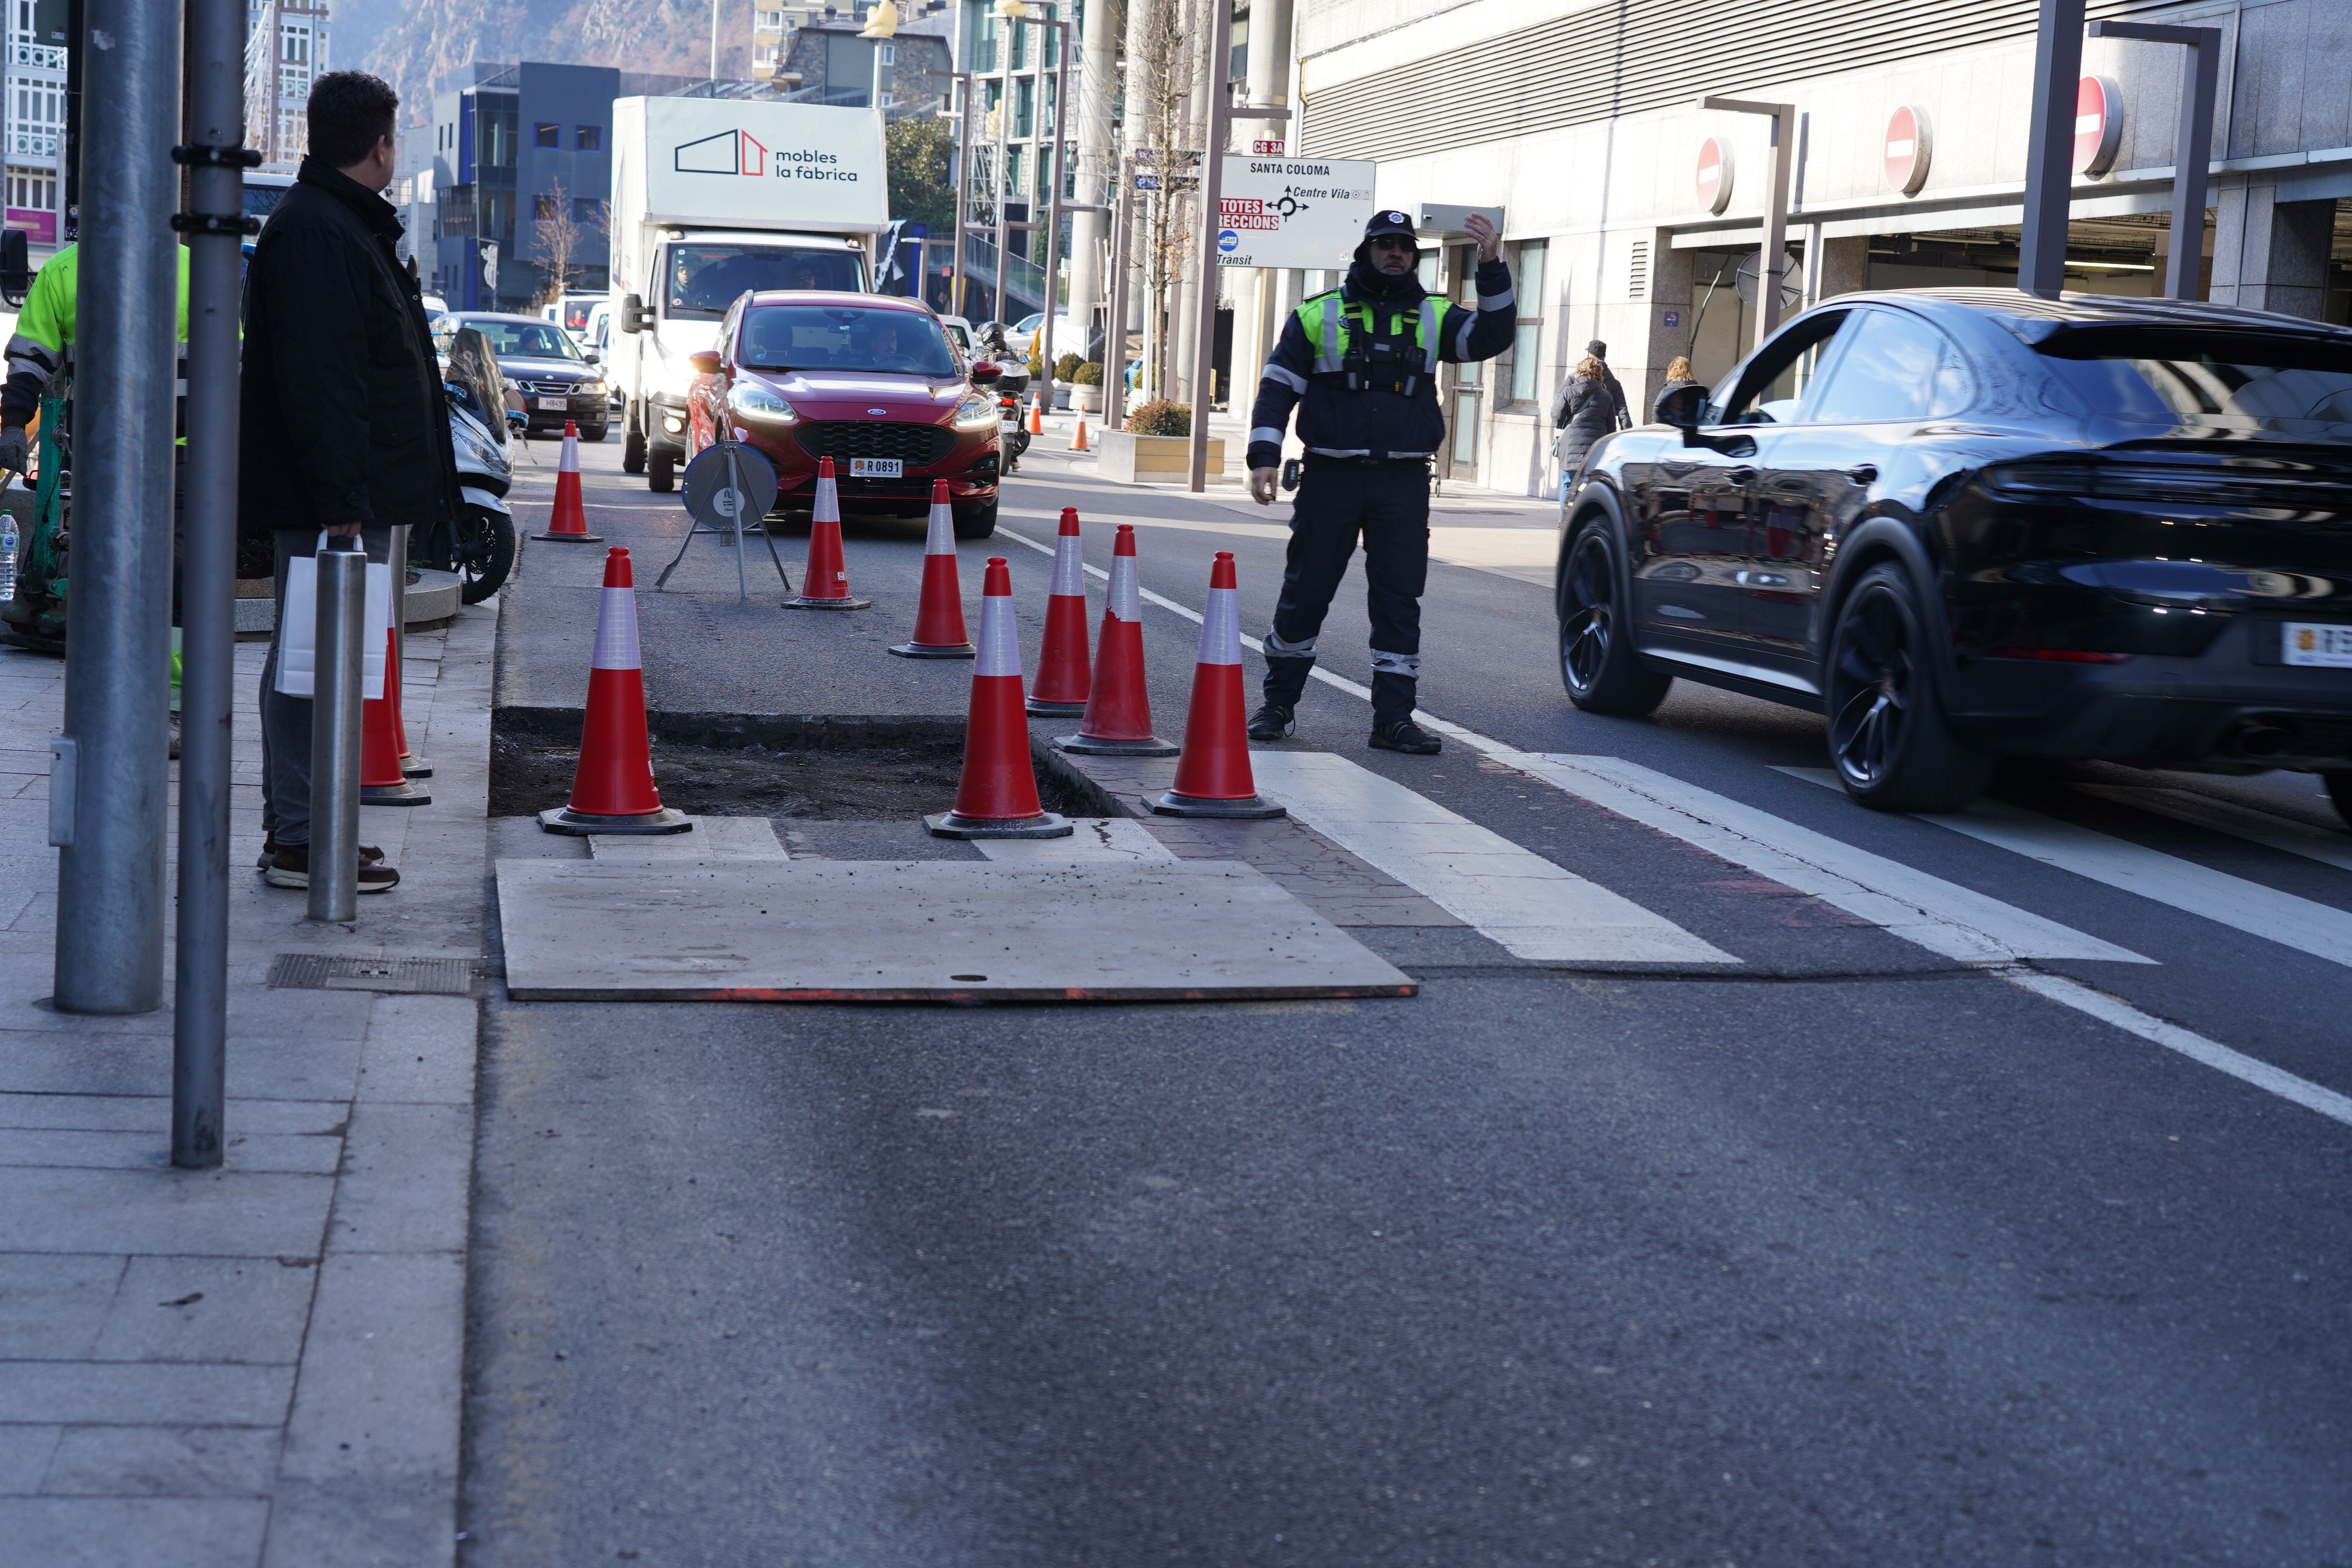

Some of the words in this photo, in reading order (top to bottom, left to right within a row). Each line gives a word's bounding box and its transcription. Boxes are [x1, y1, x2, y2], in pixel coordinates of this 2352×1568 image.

[17, 136, 56, 155] OCP
[1254, 141, 1267, 153] CG
[1270, 142, 1284, 154] 3A
[776, 149, 837, 163] mobles
[776, 165, 791, 177] la
[795, 166, 858, 181] fàbrica
[1250, 163, 1283, 174] SANTA
[1287, 164, 1330, 176] COLOMA
[1293, 186, 1327, 198] Centre
[1331, 189, 1350, 199] Vila
[1221, 200, 1260, 213] TOTES
[1219, 215, 1278, 229] RECCIONS
[1217, 254, 1252, 265] Trànsit
[868, 461, 873, 471] R
[876, 461, 899, 472] 0891
